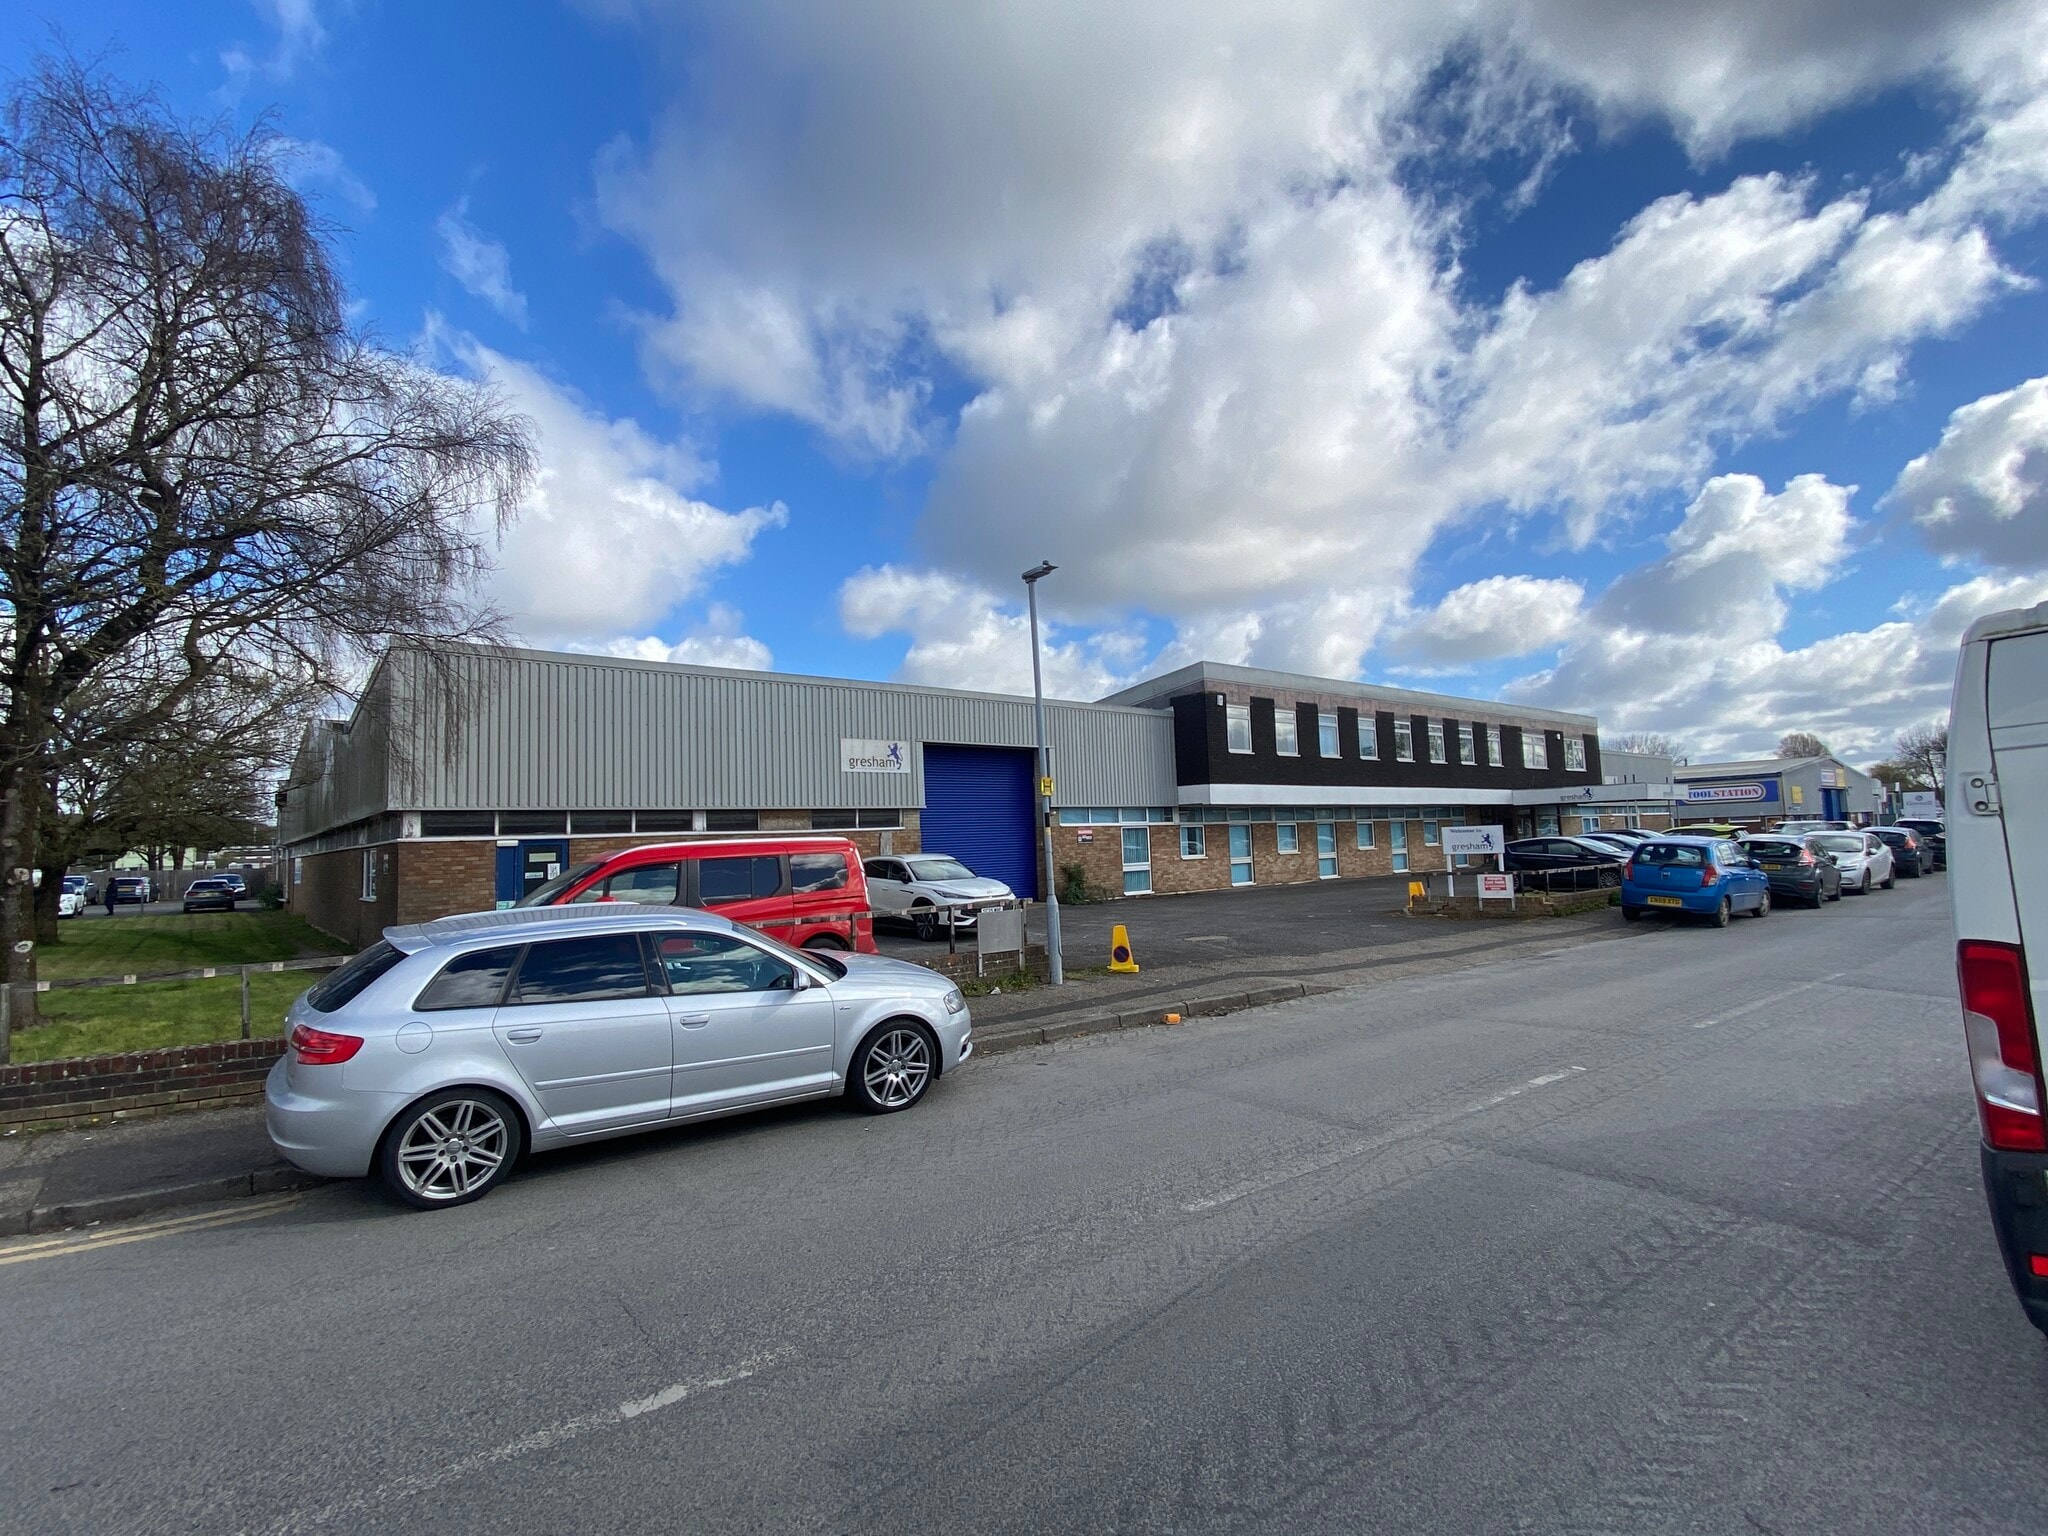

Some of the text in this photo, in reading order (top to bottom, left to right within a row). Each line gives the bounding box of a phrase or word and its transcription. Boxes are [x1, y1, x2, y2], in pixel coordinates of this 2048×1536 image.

[849, 756, 895, 769] gresham
[1043, 779, 1052, 794] H
[1451, 843, 1489, 852] gresham
